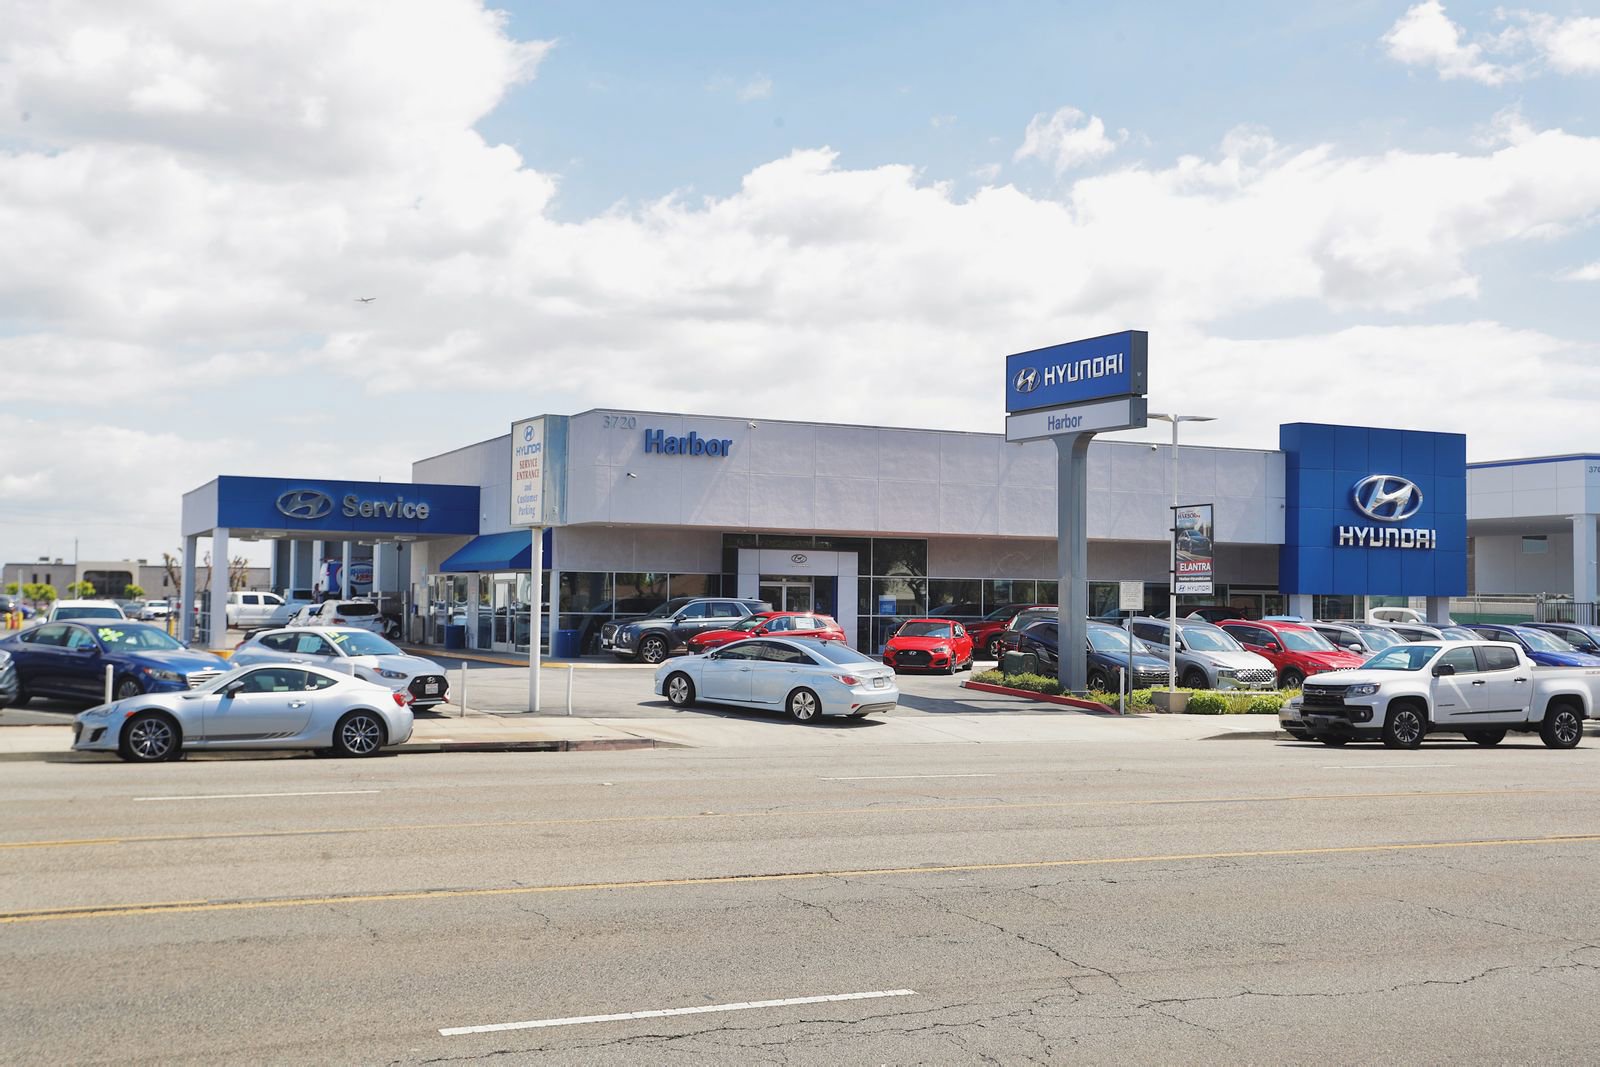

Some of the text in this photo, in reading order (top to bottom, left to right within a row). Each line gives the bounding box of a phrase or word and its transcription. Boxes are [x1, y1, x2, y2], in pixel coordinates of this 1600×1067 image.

[1044, 353, 1123, 386] HYUNDAI
[602, 415, 637, 430] 3720
[1048, 414, 1082, 431] Harbor
[516, 442, 542, 457] HYUNDAI
[645, 429, 733, 457] Harbor
[519, 458, 538, 470] SERVICE
[516, 469, 540, 481] ENTRANCE
[524, 483, 532, 492] and
[342, 494, 430, 519] Service
[517, 494, 539, 505] Customer
[518, 504, 536, 519] Parking
[1339, 526, 1436, 549] HYUNDAI
[1180, 562, 1211, 572] ELANTRA
